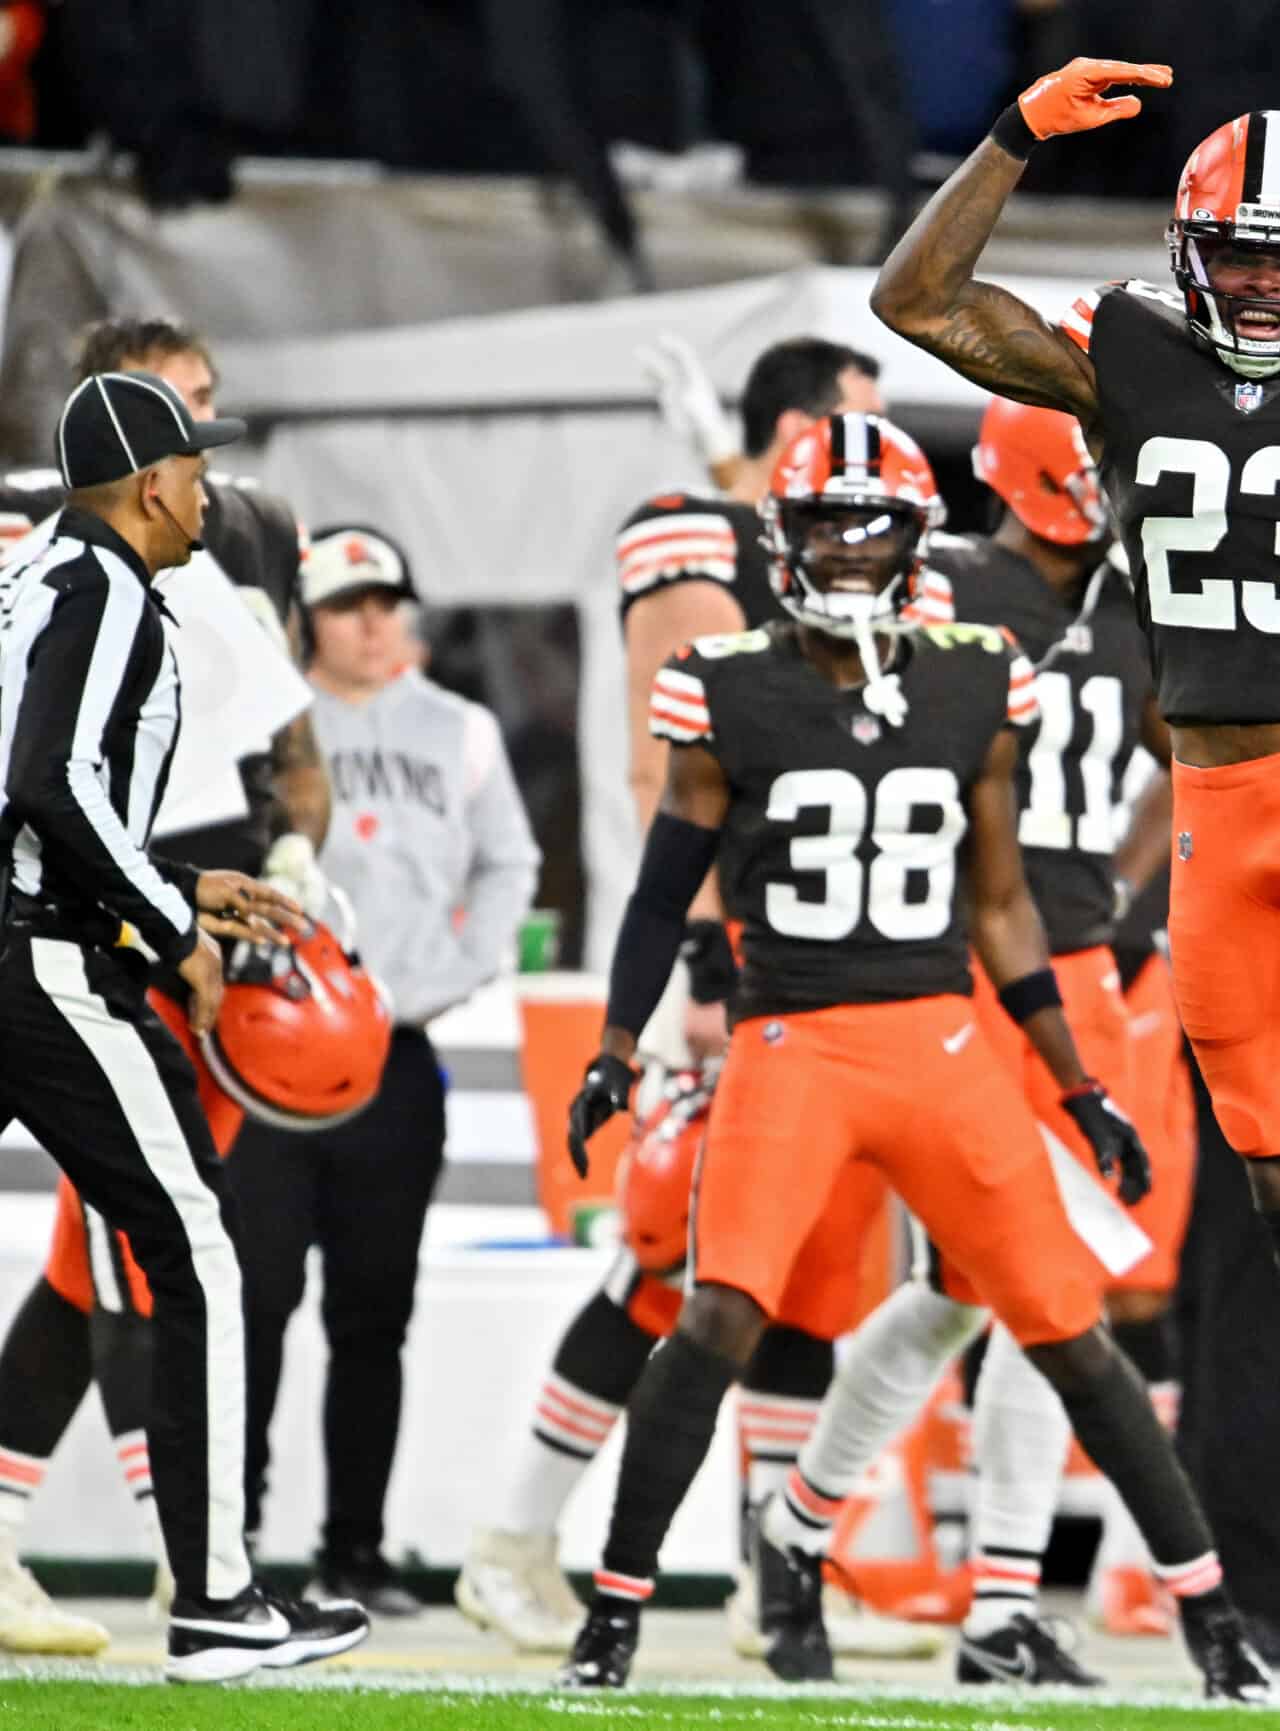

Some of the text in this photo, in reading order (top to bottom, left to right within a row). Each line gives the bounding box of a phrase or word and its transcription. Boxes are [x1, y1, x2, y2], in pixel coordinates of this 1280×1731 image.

[331, 748, 446, 817] OWNS
[1017, 671, 1131, 853] 11
[765, 768, 967, 941] 38
